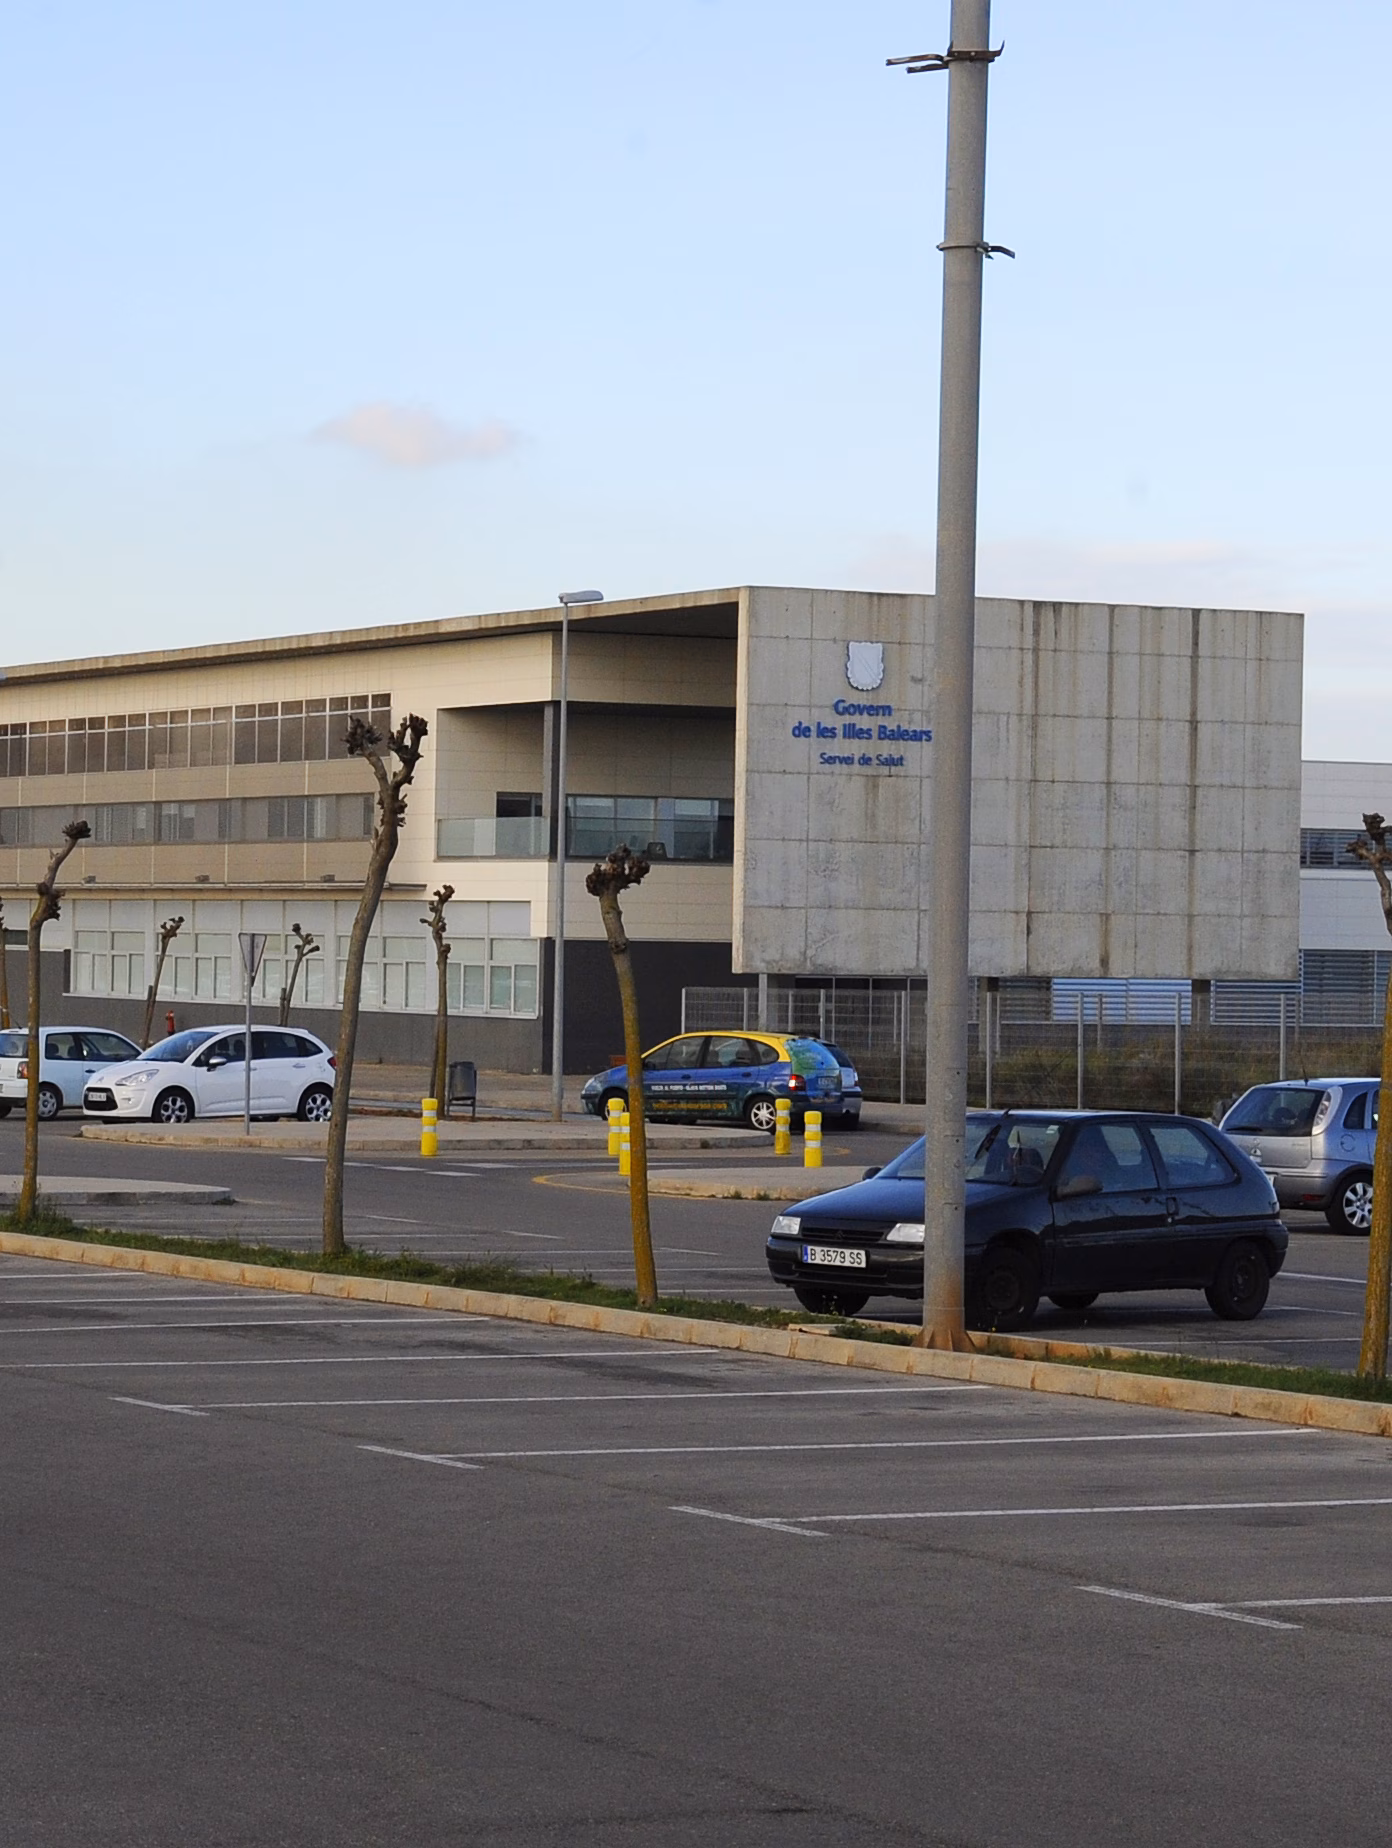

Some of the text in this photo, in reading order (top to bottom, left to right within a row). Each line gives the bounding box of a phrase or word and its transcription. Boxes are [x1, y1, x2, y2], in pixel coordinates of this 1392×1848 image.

[833, 698, 893, 717] Govern
[791, 720, 933, 743] de les Illes Balears
[819, 752, 905, 768] Servei de Salut
[810, 1248, 863, 1266] B 3579 SS
